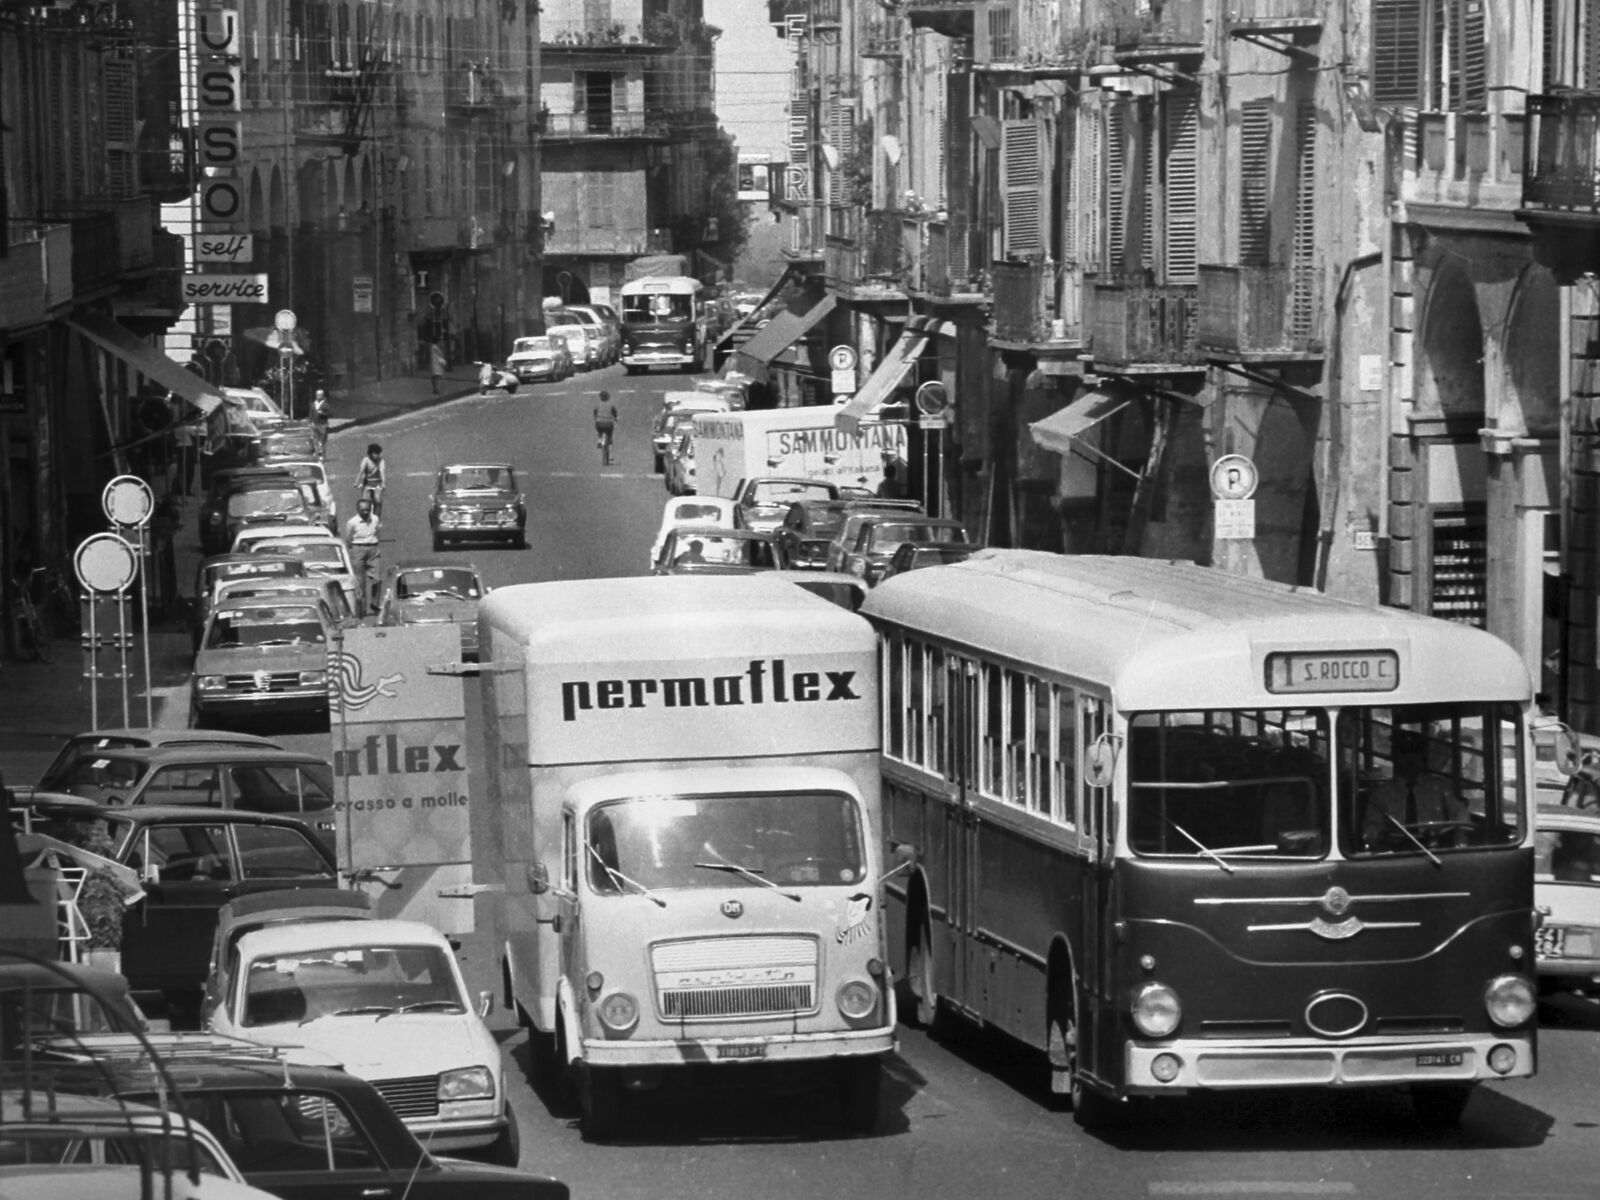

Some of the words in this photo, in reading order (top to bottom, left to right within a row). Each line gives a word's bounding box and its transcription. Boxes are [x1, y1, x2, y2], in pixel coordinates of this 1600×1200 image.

[200, 235, 248, 261] self
[184, 278, 265, 298] service
[1228, 467, 1241, 491] P
[1283, 655, 1294, 687] 1
[561, 658, 862, 722] permaflex
[402, 797, 414, 809] a
[420, 791, 468, 809] molle
